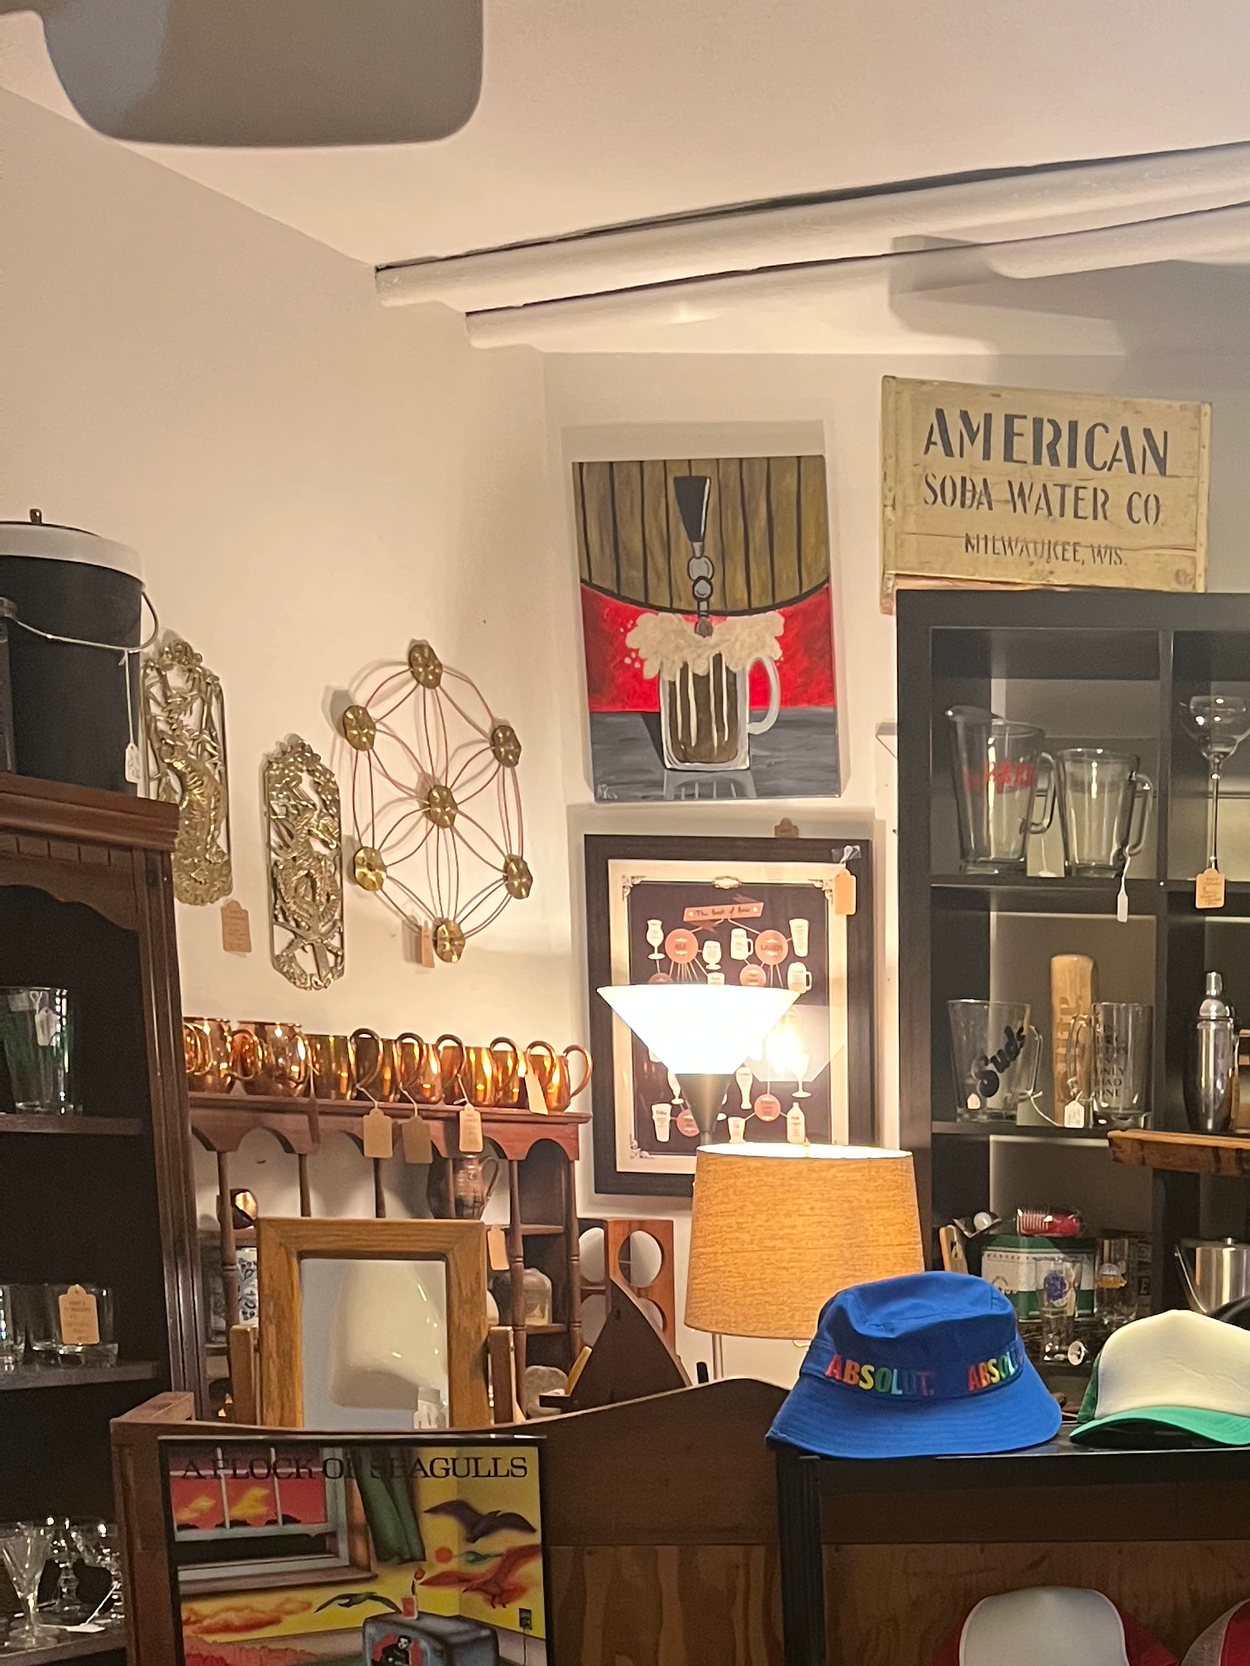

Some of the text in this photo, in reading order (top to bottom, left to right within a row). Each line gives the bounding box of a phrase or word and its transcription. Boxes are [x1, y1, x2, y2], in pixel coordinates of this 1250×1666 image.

[923, 407, 1169, 477] AMERICAN
[923, 473, 994, 511] SODA
[1007, 480, 1110, 522] WATER
[1090, 542, 1128, 567] WIS.
[182, 1457, 528, 1479] A FLOCK OF SEAGULLS
